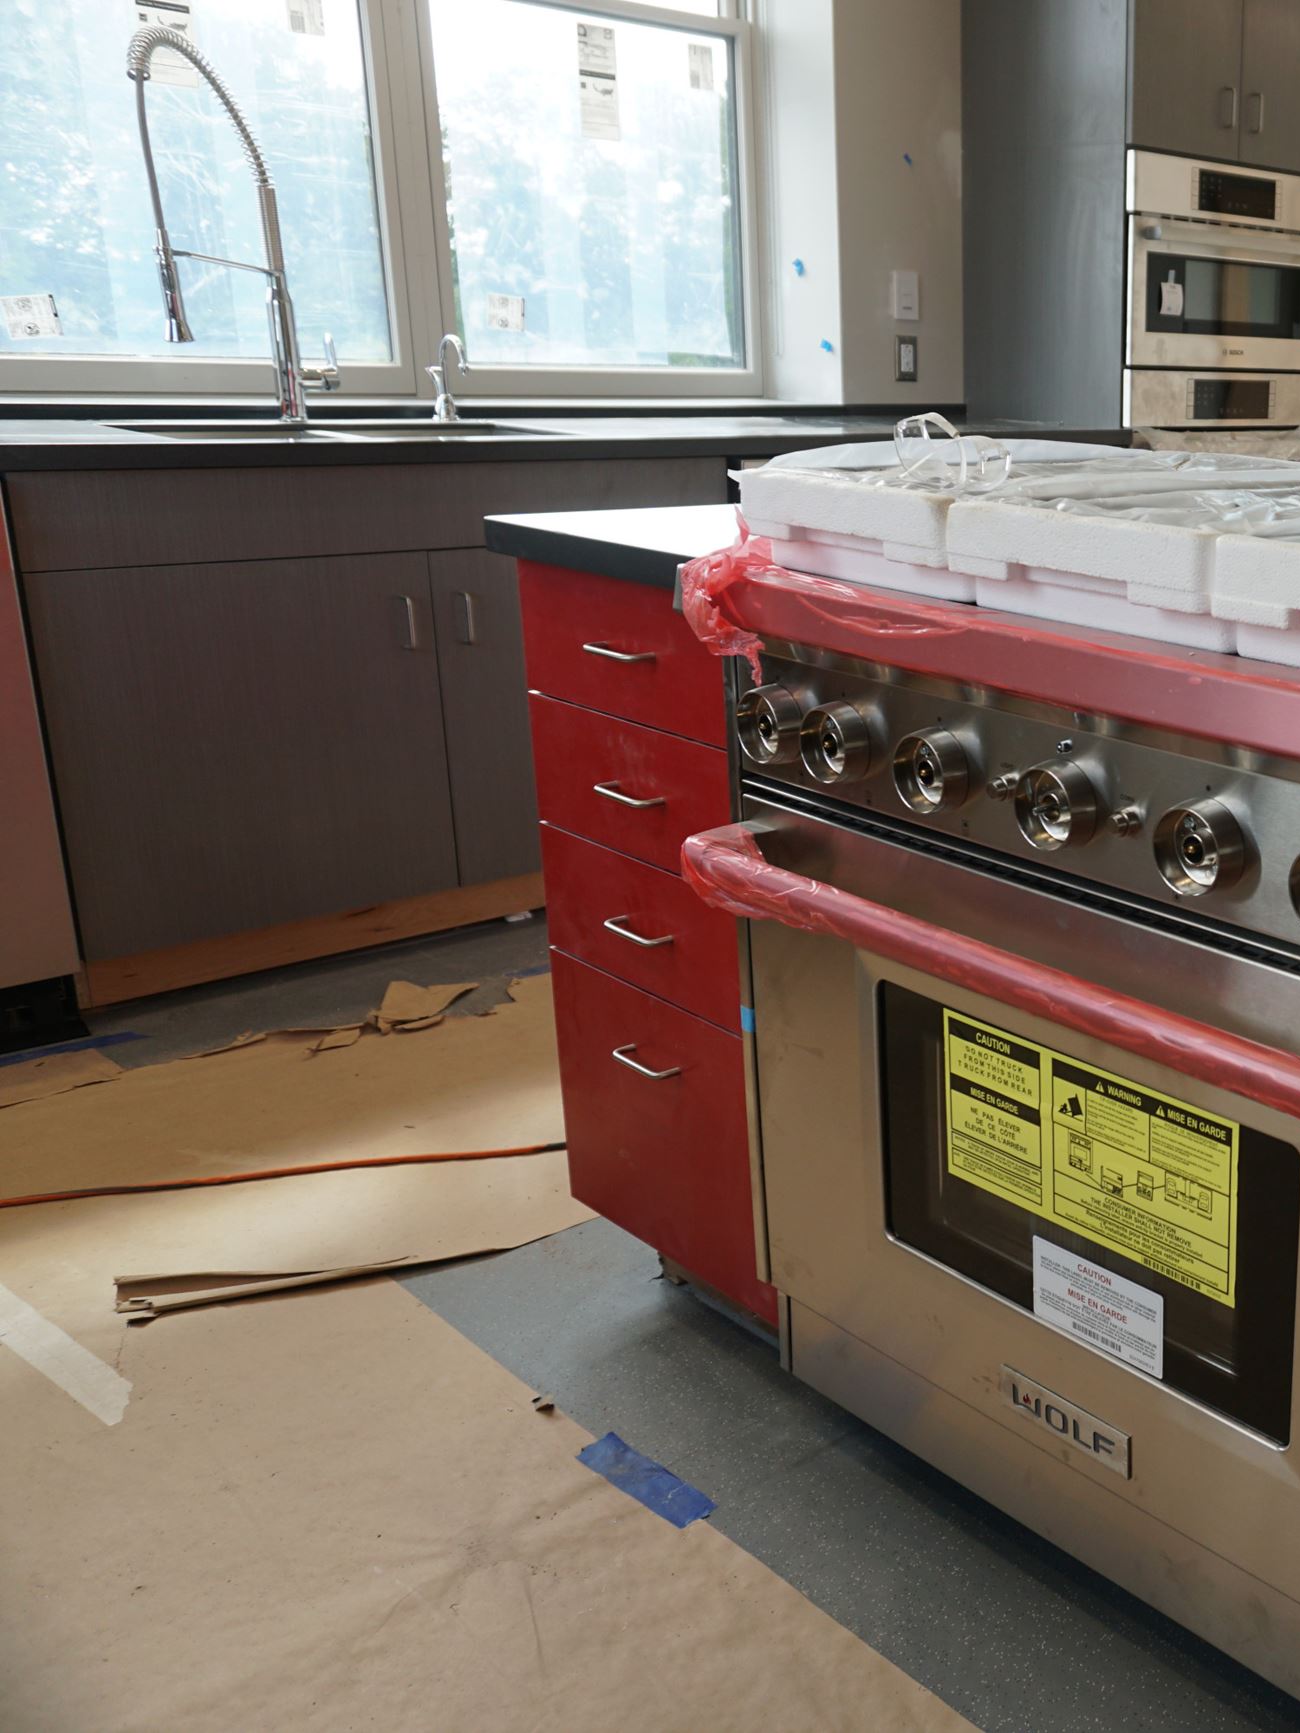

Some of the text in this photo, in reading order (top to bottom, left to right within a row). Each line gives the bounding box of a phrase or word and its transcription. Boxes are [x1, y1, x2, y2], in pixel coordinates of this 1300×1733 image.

[976, 1033, 1010, 1054] CAUTION
[964, 1053, 1026, 1084] FROM THIS SIDE
[966, 1046, 1022, 1074] DO NOT TRUCK
[987, 1072, 1008, 1086] FROM
[1012, 1082, 1032, 1096] REAR
[1107, 1085, 1142, 1106] WARNING
[970, 1087, 1019, 1114] MISE EN GARDE
[970, 1106, 978, 1114] NE
[982, 1111, 994, 1121] PAS
[976, 1117, 983, 1126] DE
[988, 1122, 996, 1131] CE
[989, 1132, 996, 1140] DE
[1167, 1109, 1185, 1124] MISE
[1187, 1117, 1197, 1130] EN
[1199, 1122, 1226, 1140] GARDE
[1090, 1197, 1192, 1247] THE INSTALLER SHALL NOT REMOVE
[1104, 1197, 1176, 1235] CONSUMER INFORMATION
[1077, 1263, 1112, 1286] CAUTION
[1067, 1288, 1086, 1304] MISE
[1088, 1298, 1098, 1310] EN
[1100, 1304, 1128, 1324] GARDE
[1012, 1383, 1116, 1454] WOLF
